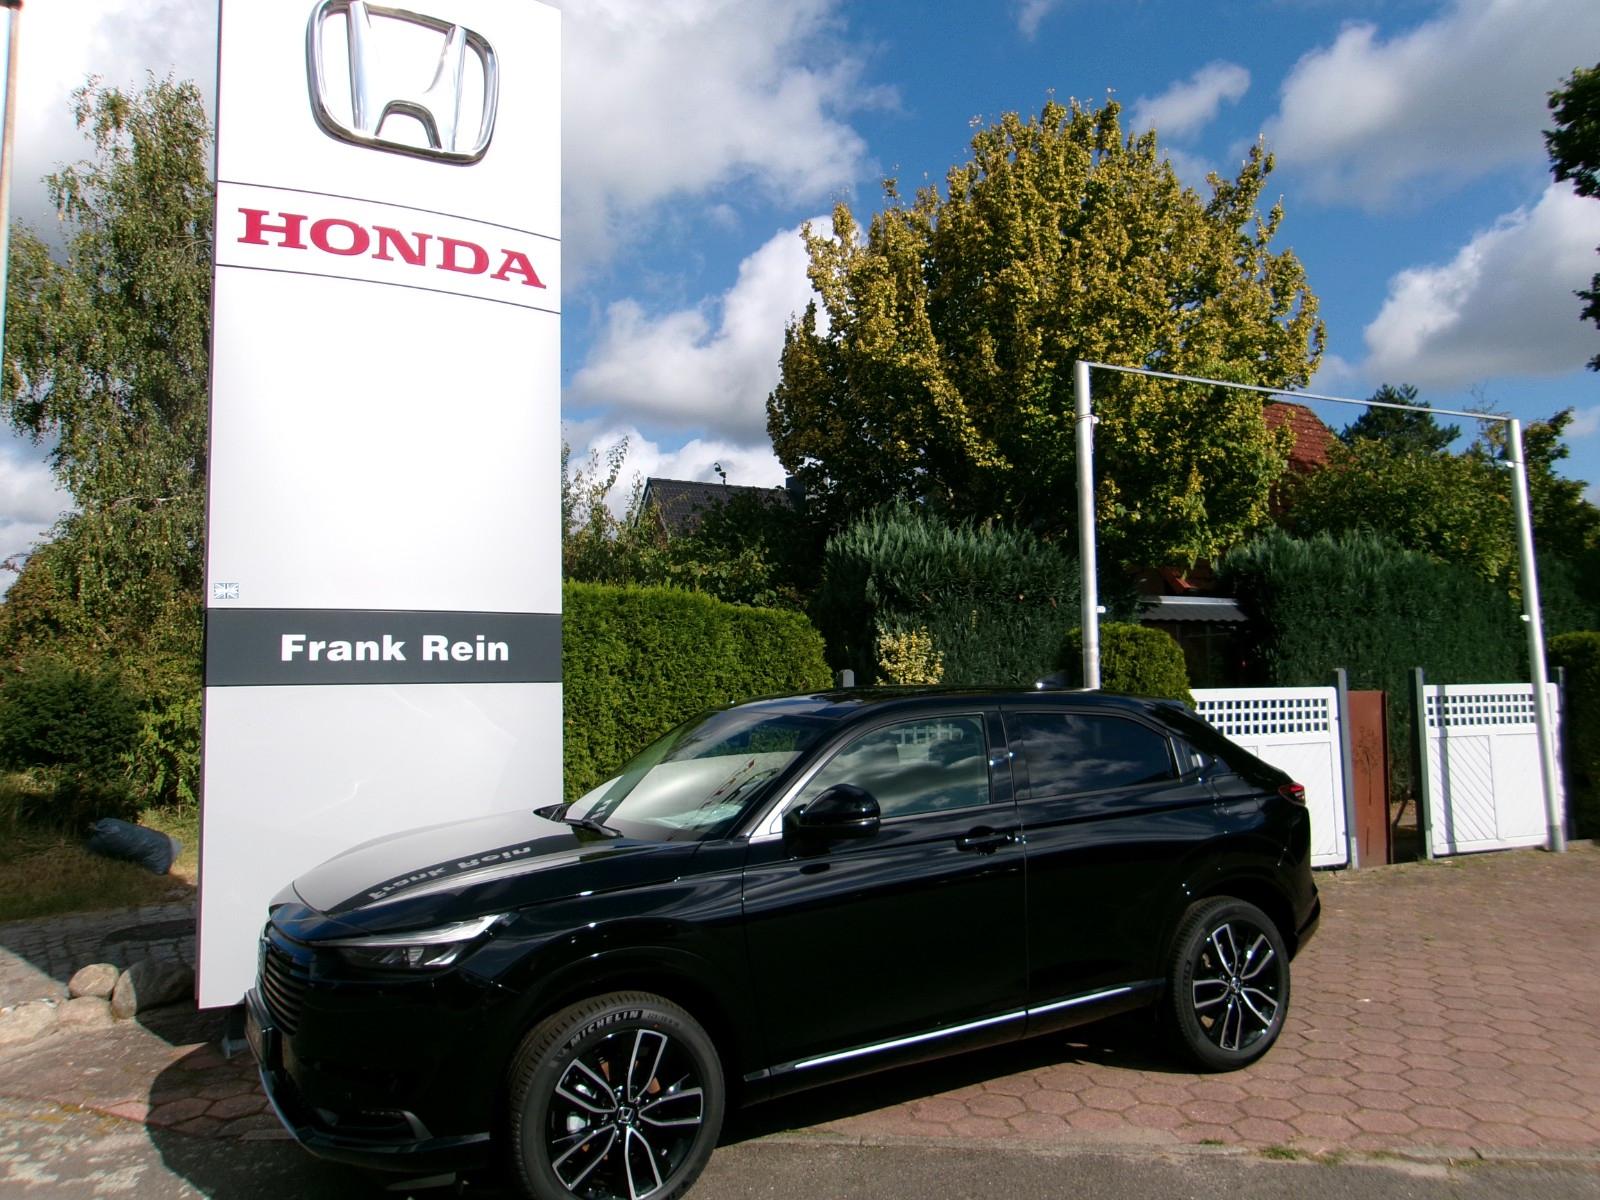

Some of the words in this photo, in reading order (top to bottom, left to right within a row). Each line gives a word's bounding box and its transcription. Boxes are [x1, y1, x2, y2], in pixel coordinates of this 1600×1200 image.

[237, 207, 546, 289] HONDA
[281, 634, 406, 662] Frank
[422, 635, 509, 662] Rein
[570, 1010, 639, 1047] MICHELIN
